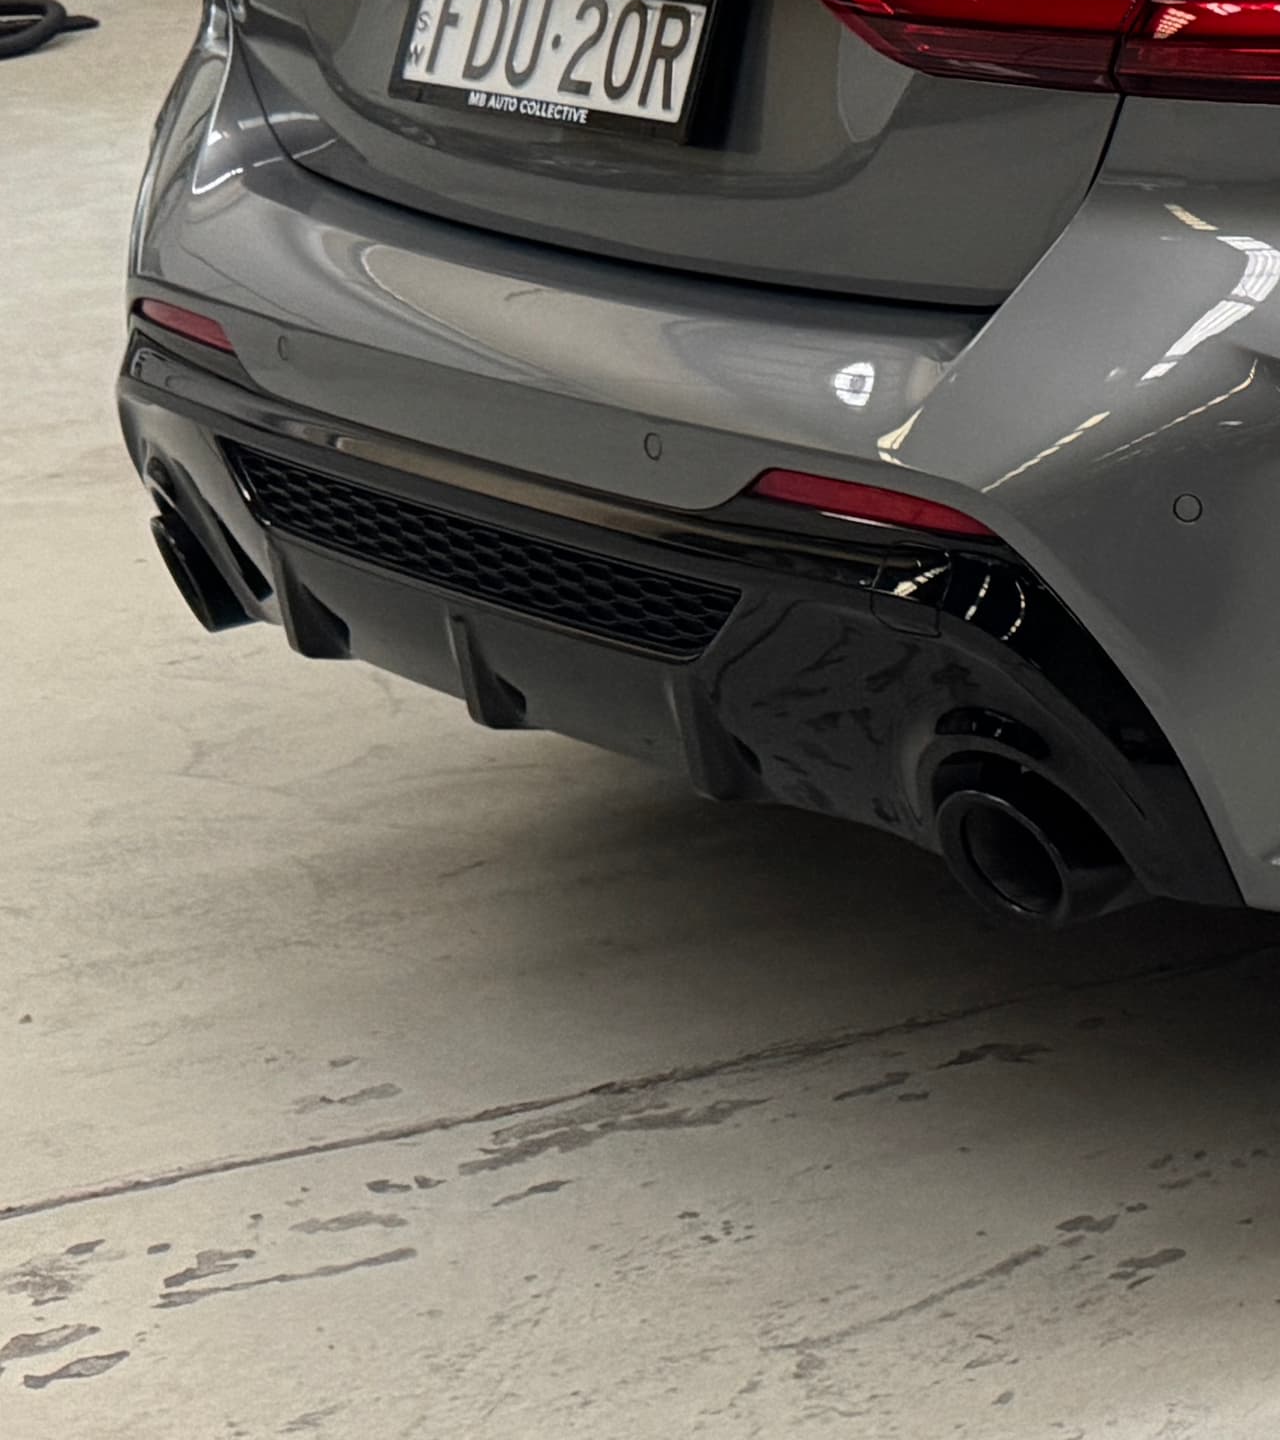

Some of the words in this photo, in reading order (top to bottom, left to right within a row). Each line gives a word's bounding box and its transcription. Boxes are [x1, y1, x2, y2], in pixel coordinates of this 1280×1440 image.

[467, 90, 487, 107] MB
[487, 94, 518, 114] AUTO
[519, 99, 589, 124] COLLECTIVE
